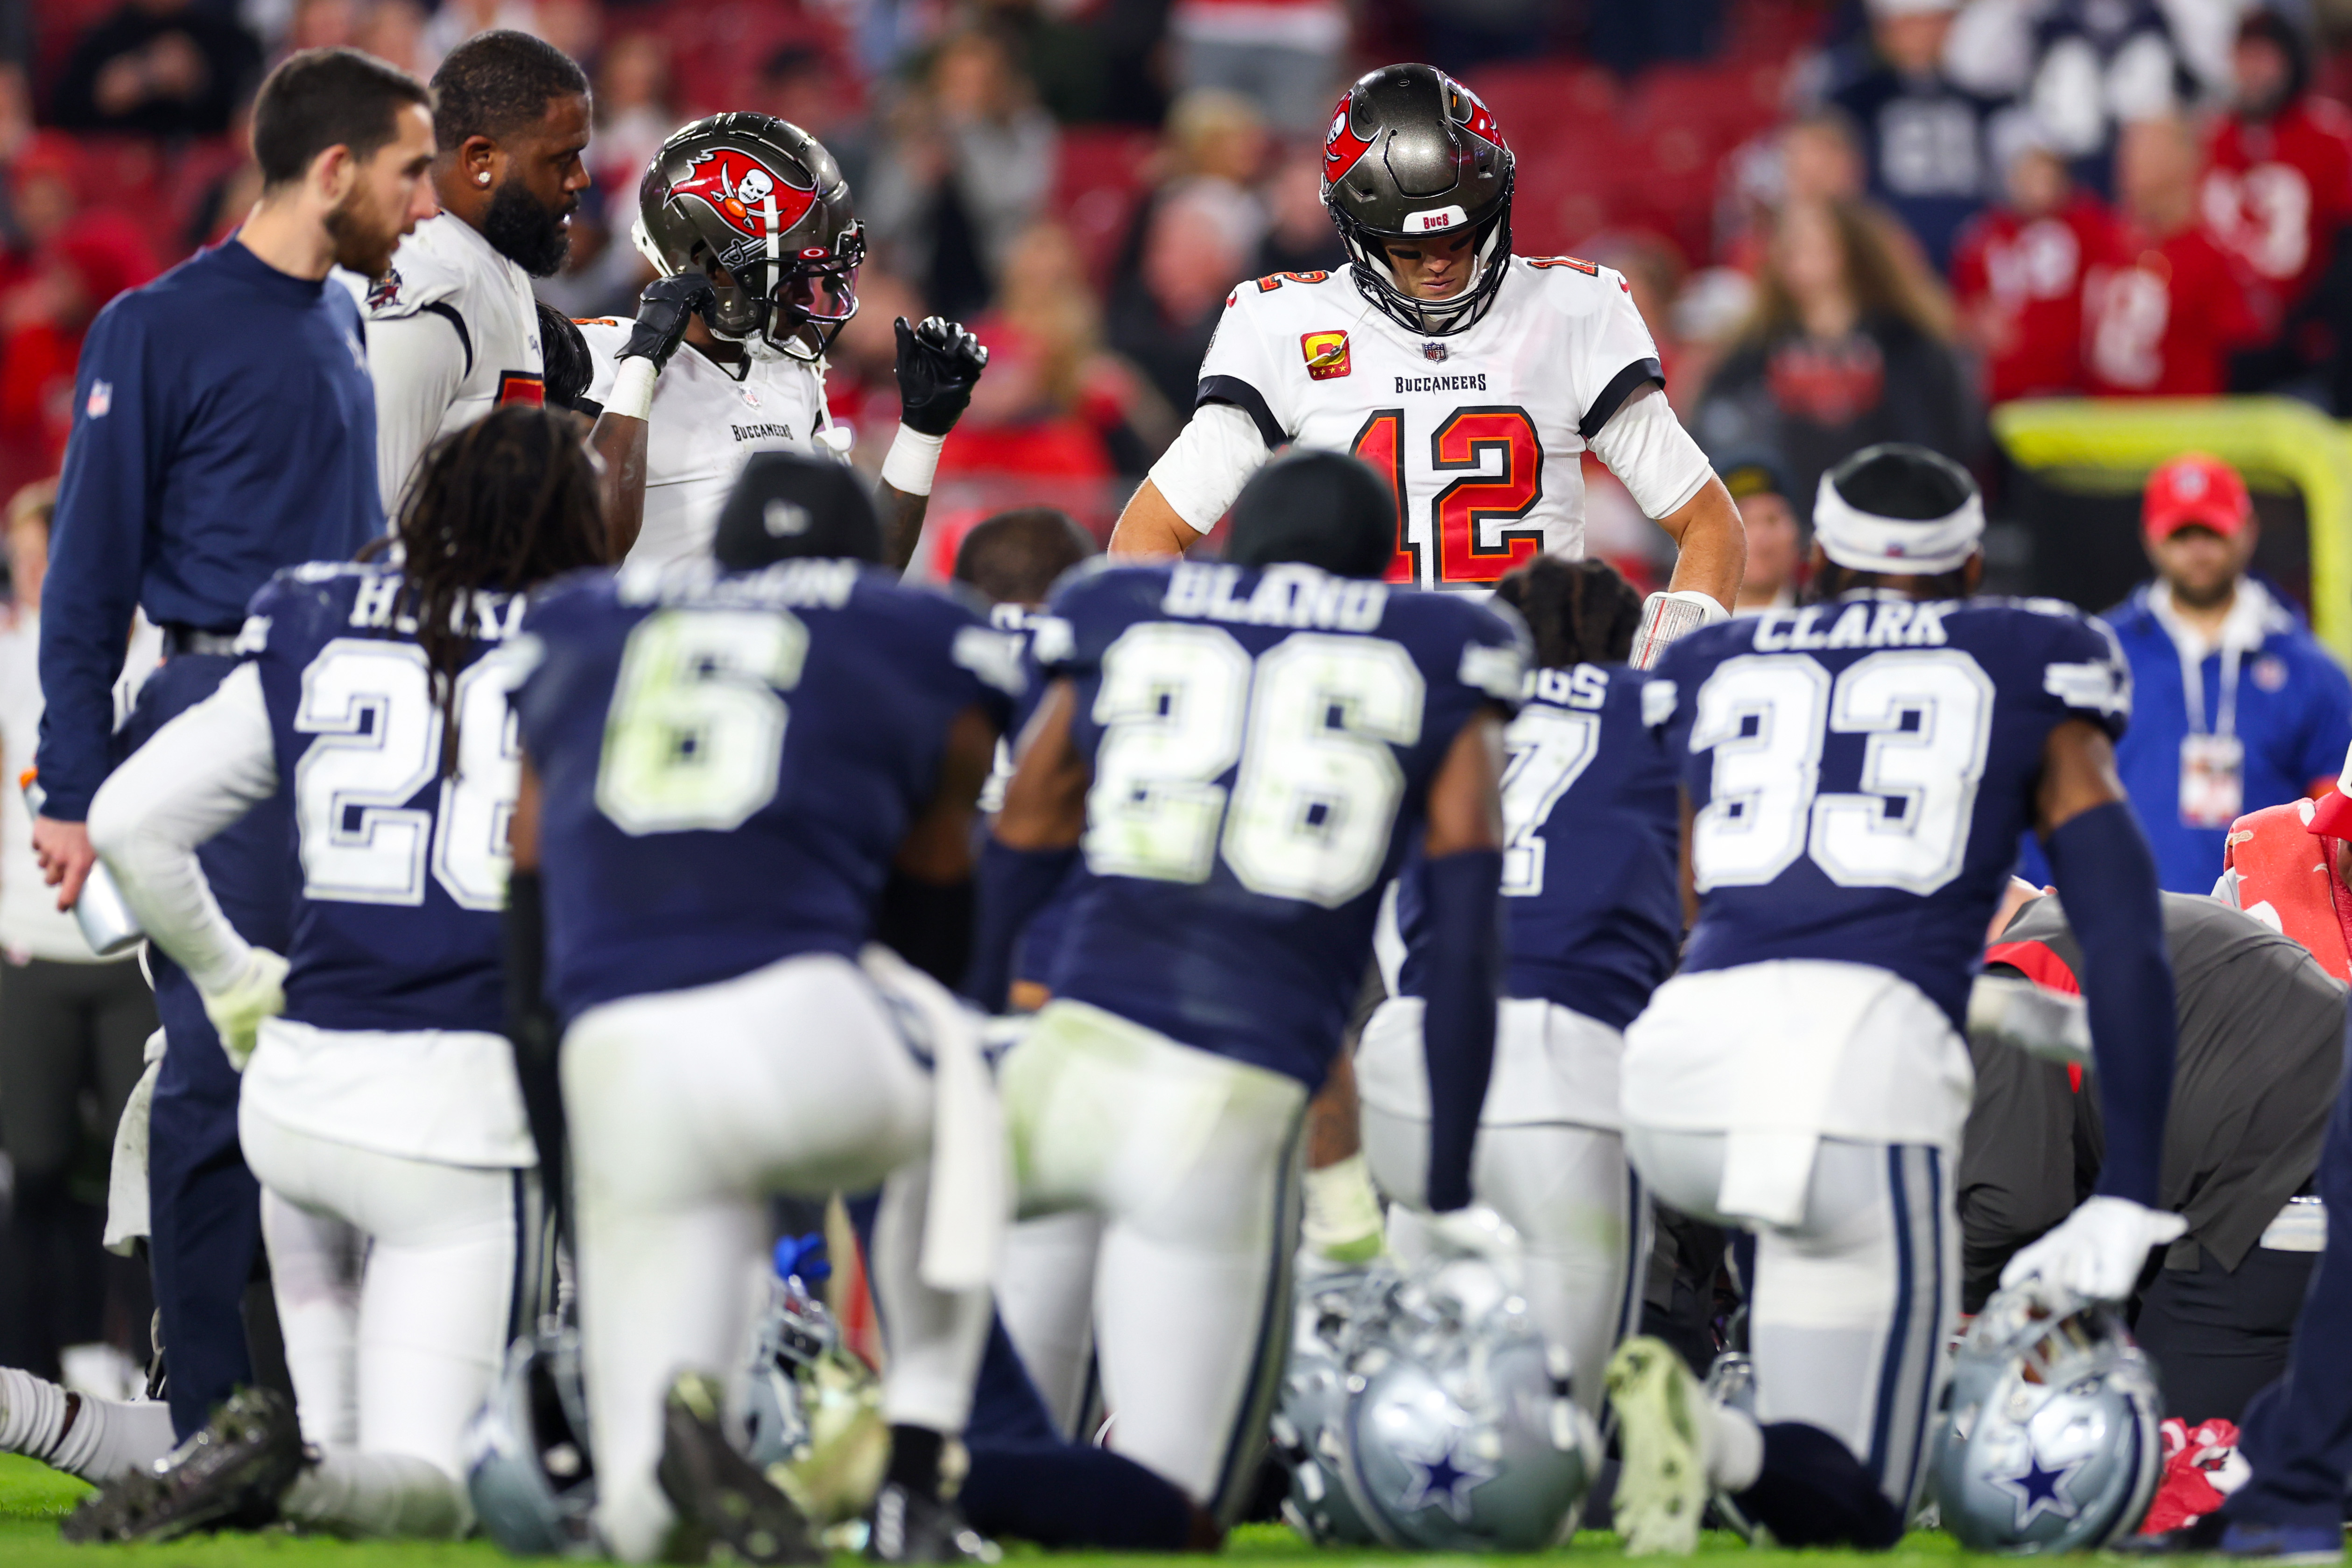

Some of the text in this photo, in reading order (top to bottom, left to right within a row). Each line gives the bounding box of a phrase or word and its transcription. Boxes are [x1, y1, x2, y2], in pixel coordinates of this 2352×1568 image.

[1423, 213, 1449, 229] BUCS
[1305, 333, 1346, 368] C
[1427, 350, 1444, 360] NFL
[1394, 373, 1486, 395] BUCCANEERS
[730, 423, 794, 442] BUCCANEERS
[1348, 405, 1544, 591] 12
[1162, 561, 1392, 633] BLAND
[1753, 601, 1952, 652] CLARK
[595, 608, 812, 838] 6
[1080, 622, 1426, 908] 26
[1689, 648, 1996, 897] 33
[1499, 704, 1601, 898] 7
